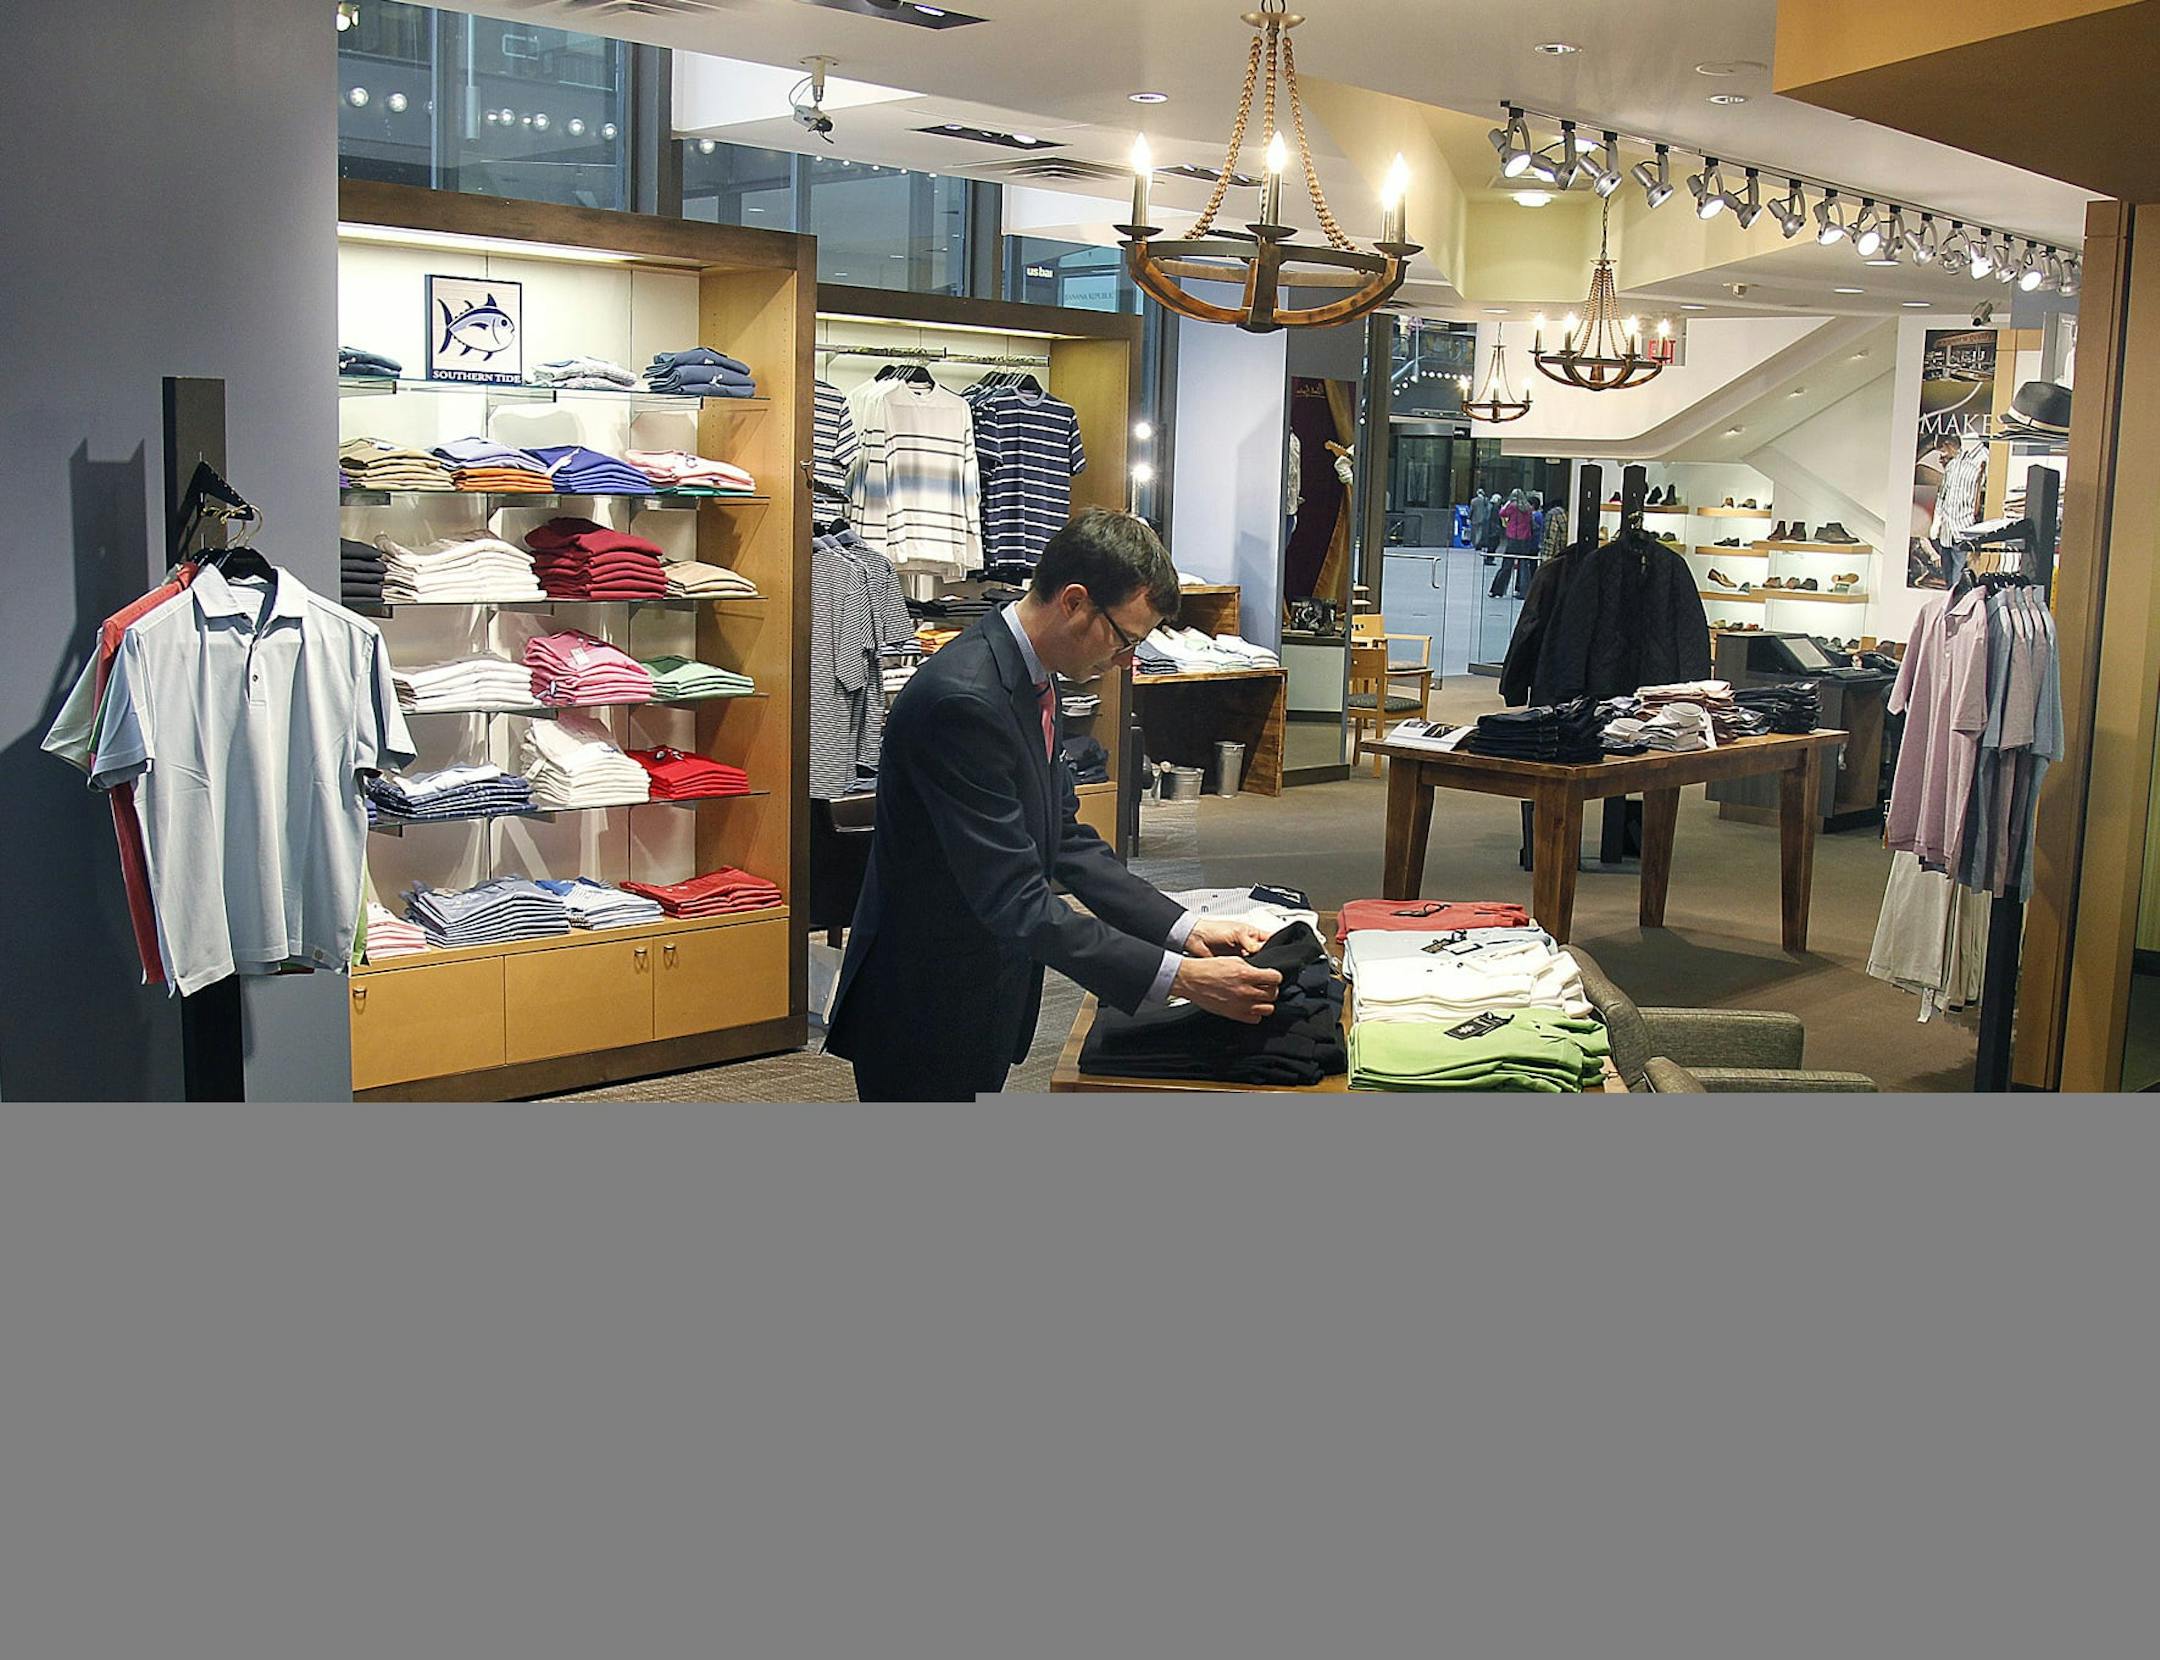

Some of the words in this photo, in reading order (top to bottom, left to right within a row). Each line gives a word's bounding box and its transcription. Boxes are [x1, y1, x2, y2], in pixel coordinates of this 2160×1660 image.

[1648, 338, 1677, 364] EIT
[432, 370, 493, 382] SOUTHERN
[494, 374, 521, 384] TIDE
